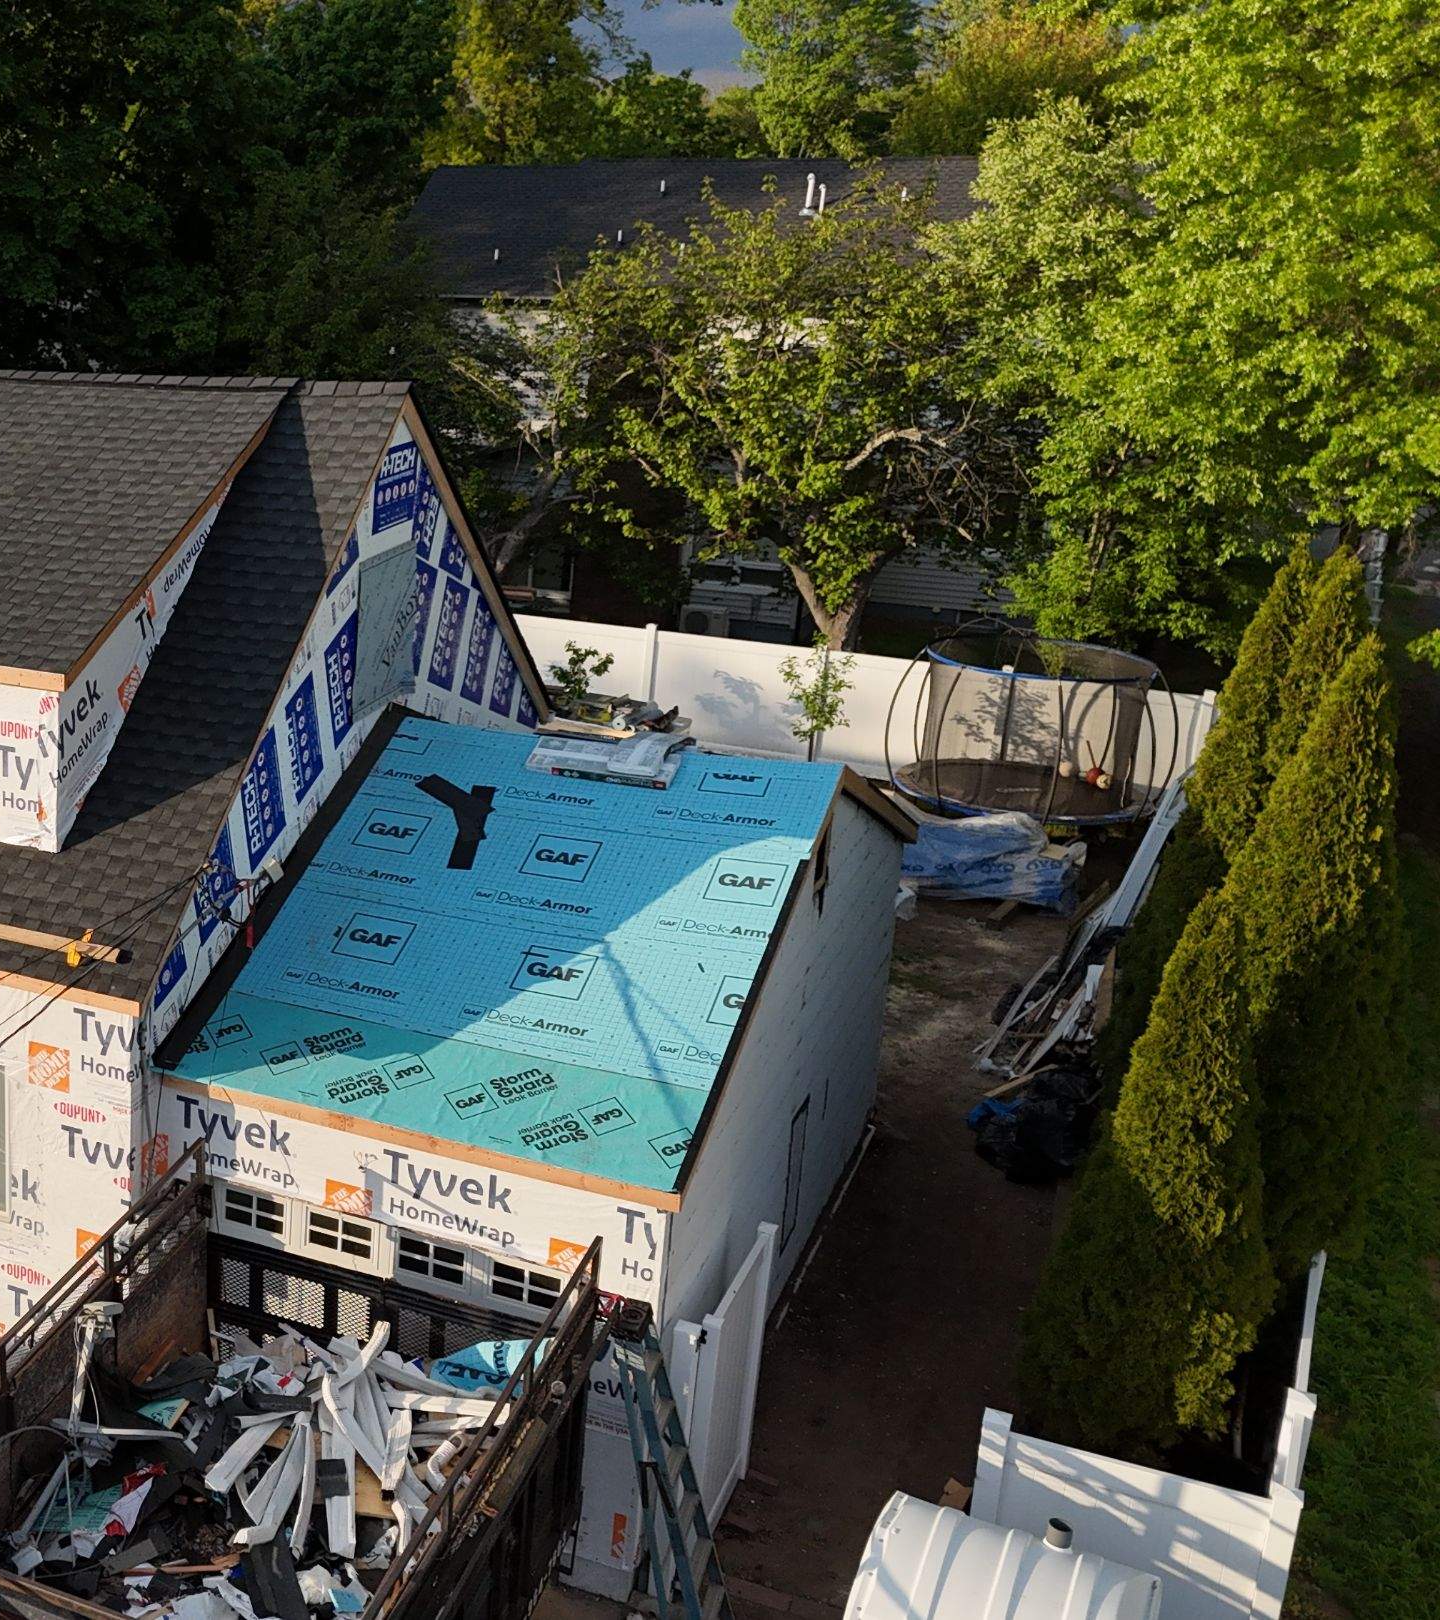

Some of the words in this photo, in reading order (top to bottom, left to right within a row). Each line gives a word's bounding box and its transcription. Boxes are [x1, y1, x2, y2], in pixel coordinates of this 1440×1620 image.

[328, 652, 345, 732] R-TECH
[504, 786, 595, 807] Deck-Armor
[243, 772, 262, 854] R-TECH
[679, 809, 777, 827] Deck-Armor
[368, 822, 418, 839] GAF
[535, 849, 589, 867] GAF
[328, 861, 416, 885] Deck-Armor
[718, 873, 775, 890] GAF
[497, 891, 593, 915] Deck-Armor
[349, 928, 402, 948] GAF
[527, 962, 584, 982] GAF
[308, 972, 400, 1000] Deck-Armor
[487, 1008, 589, 1037] Deck-Armor
[303, 1026, 353, 1047] Storm
[309, 1032, 363, 1055] Guard
[269, 1050, 299, 1066] GAF
[394, 1064, 424, 1080] GAF
[489, 1067, 542, 1090] Storm
[327, 1074, 383, 1100] Guard
[340, 1083, 390, 1104] Storm
[496, 1073, 555, 1100] Guard
[503, 1094, 526, 1105] Leak
[527, 1083, 559, 1098] Barrier
[455, 1092, 487, 1109] GAF
[176, 1095, 291, 1156] Tyvek
[551, 1112, 574, 1126] Leak
[592, 1107, 622, 1125] GAF
[521, 1119, 581, 1146] Guard
[534, 1129, 589, 1151] Storm
[383, 1149, 512, 1214] Tyvek
[389, 1198, 515, 1247] HomeWrap
[7, 1263, 46, 1285] DUPONT
[622, 1259, 654, 1281] Ho
